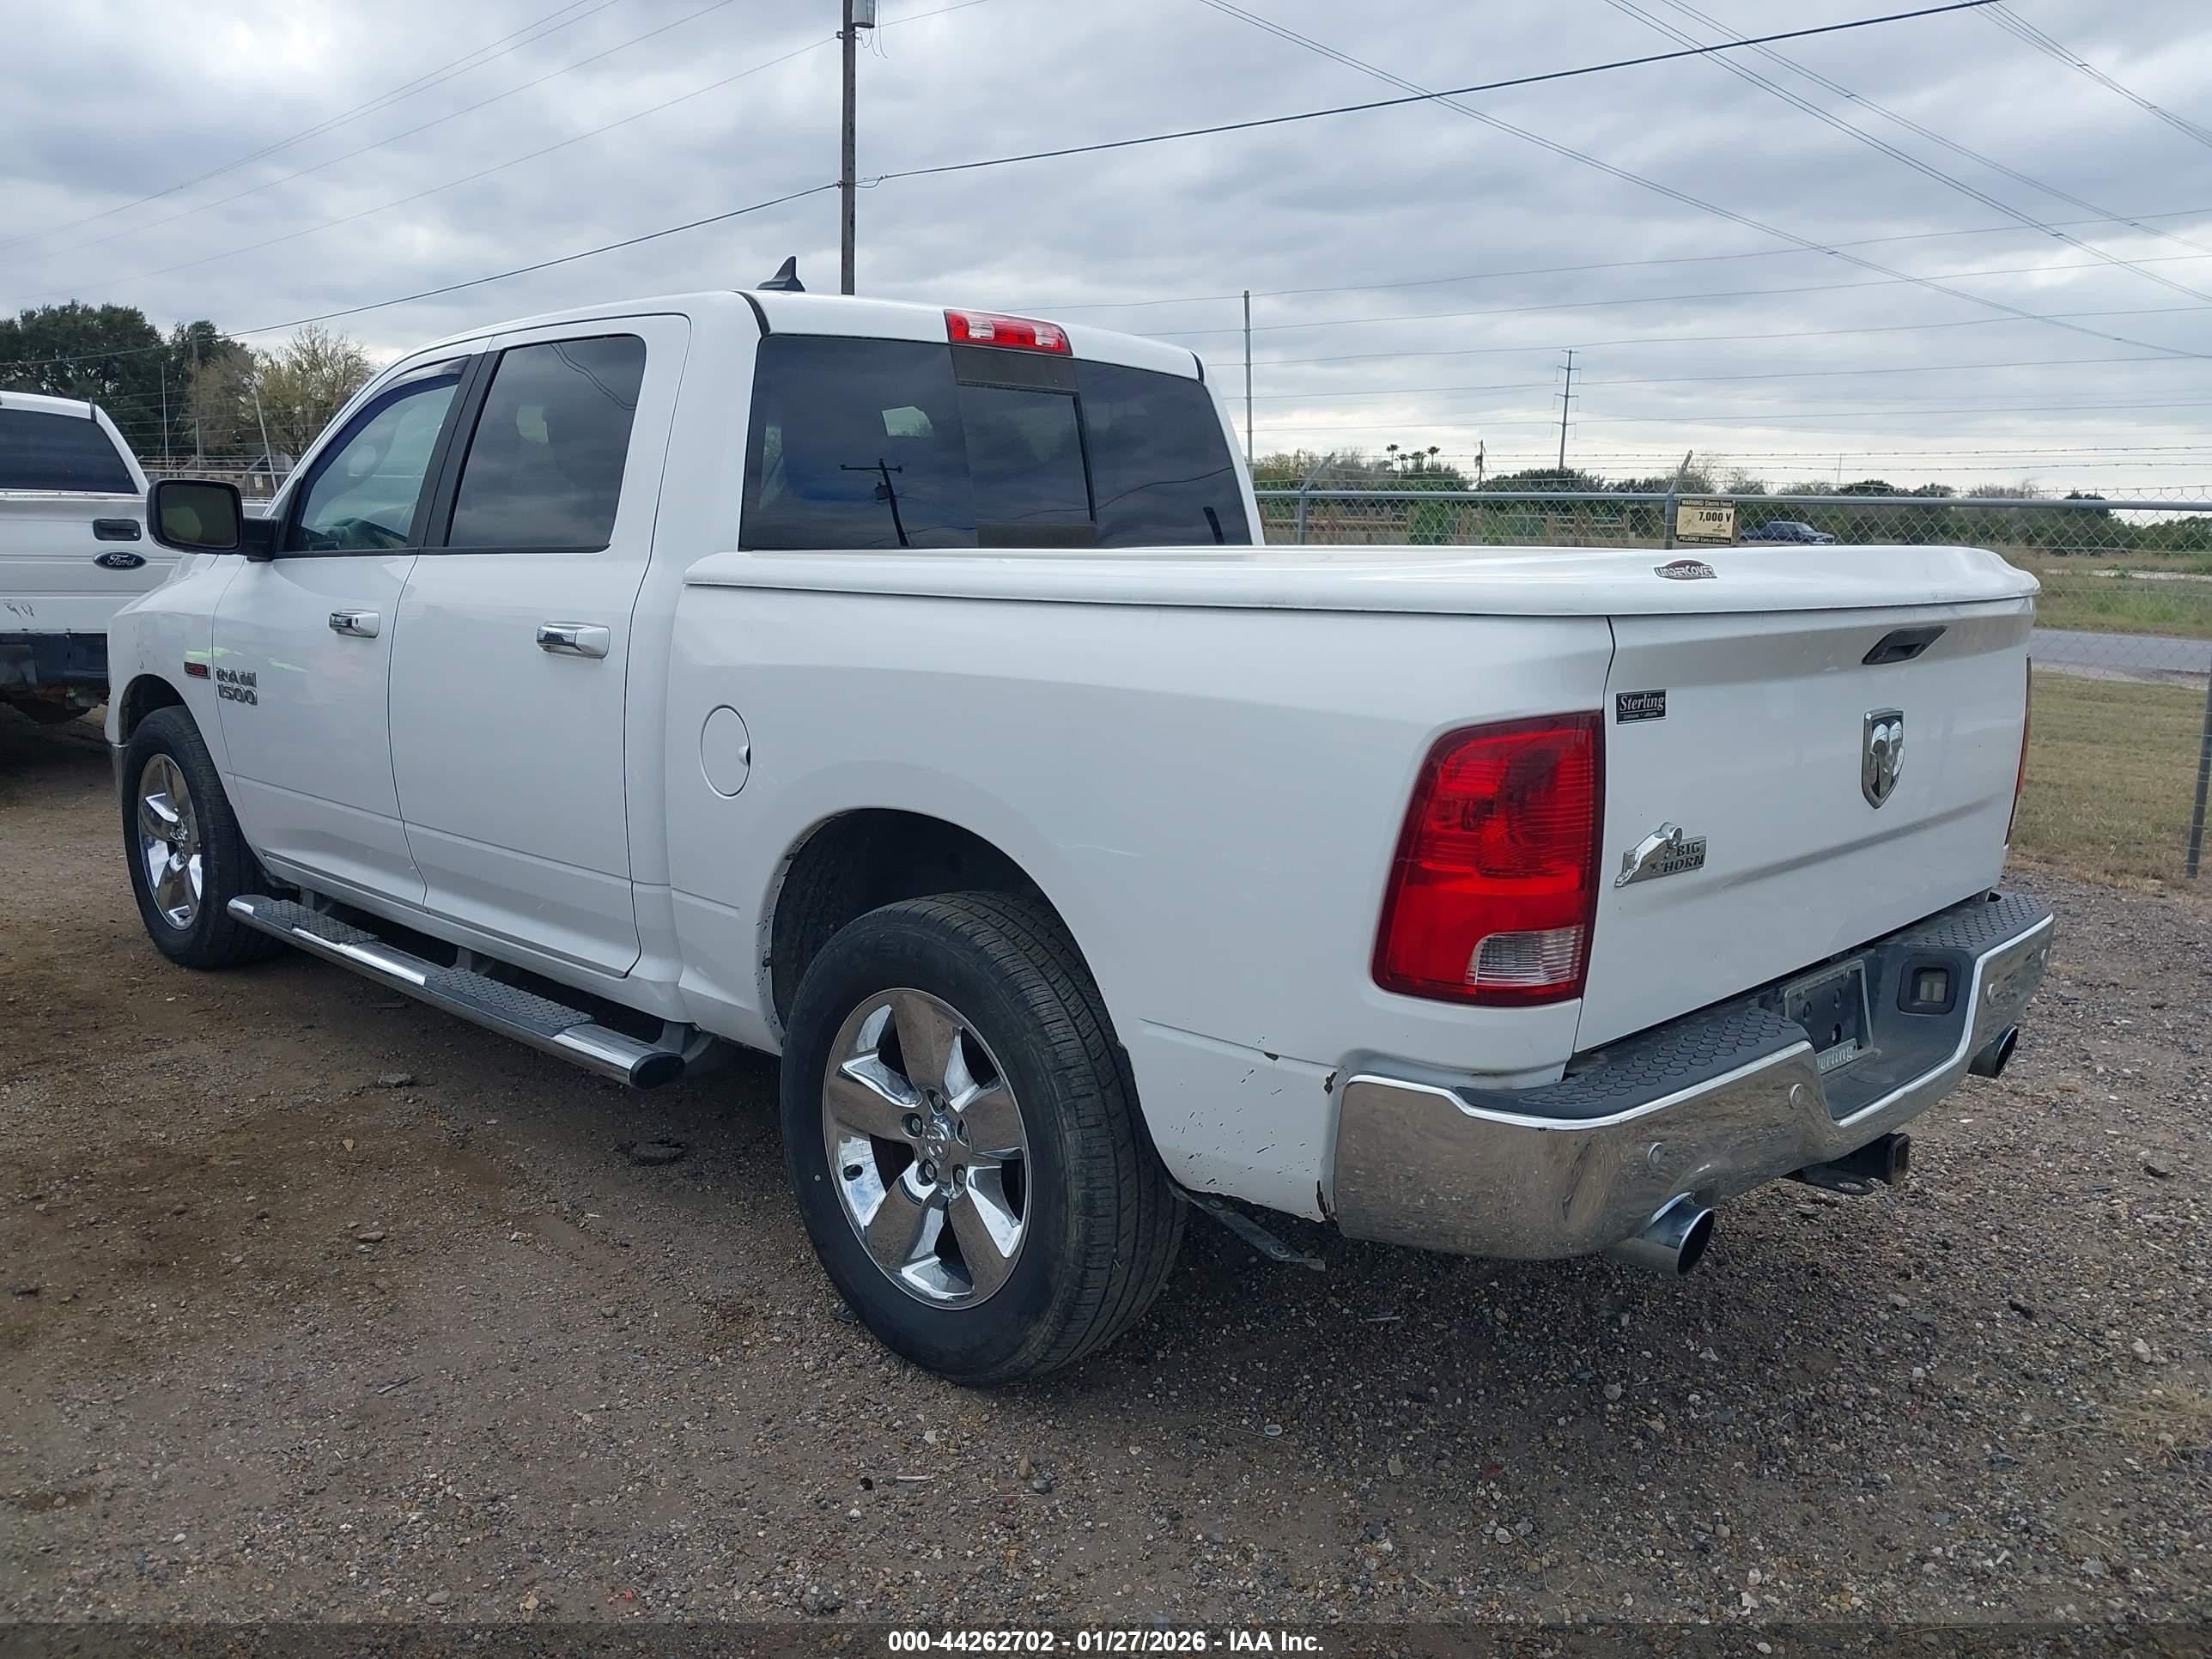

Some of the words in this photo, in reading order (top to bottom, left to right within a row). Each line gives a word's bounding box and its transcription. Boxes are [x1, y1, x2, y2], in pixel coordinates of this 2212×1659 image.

[1698, 511, 1723, 523] 7,000
[1725, 513, 1732, 523] V
[106, 554, 137, 566] Ford
[216, 666, 258, 689] RAM
[217, 684, 258, 707] 1500
[1620, 693, 1665, 712] Sterling
[1676, 842, 1700, 857] BIG
[1662, 854, 1705, 873] HORN
